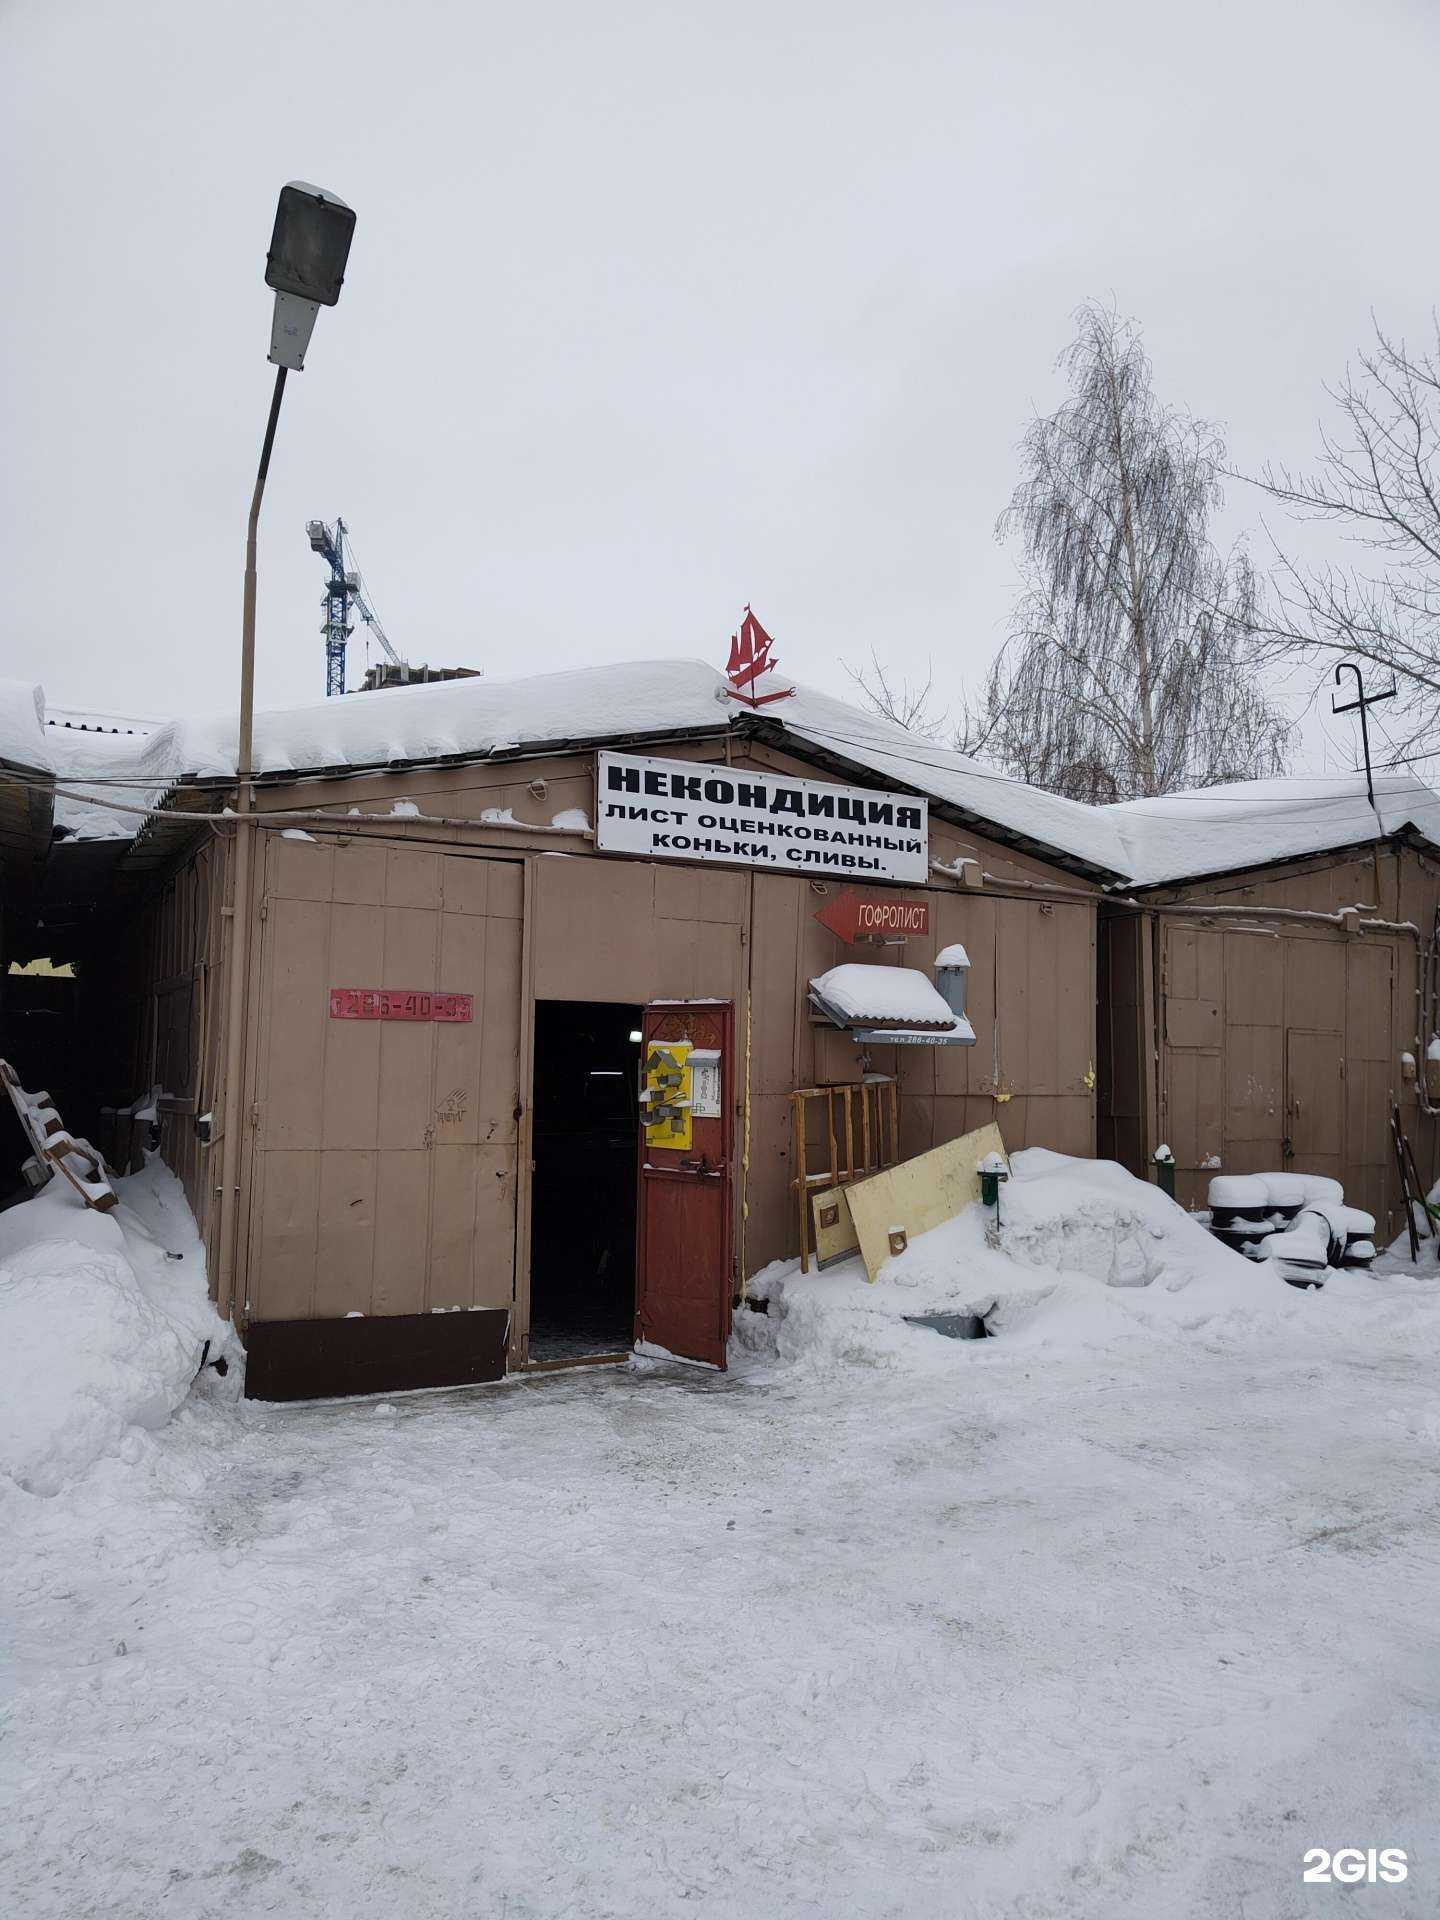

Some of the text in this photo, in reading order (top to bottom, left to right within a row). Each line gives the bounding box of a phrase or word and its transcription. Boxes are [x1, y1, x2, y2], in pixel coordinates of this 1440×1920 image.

[608, 766, 921, 829] НЕКОНДИЦИЯ
[605, 804, 921, 853] ЛИСТ ОЦЕНКОВАННЫЙ
[652, 833, 887, 870] КОНЬКИ, СЛИВЫ.
[858, 904, 925, 929] ГОФРОЛИСТ
